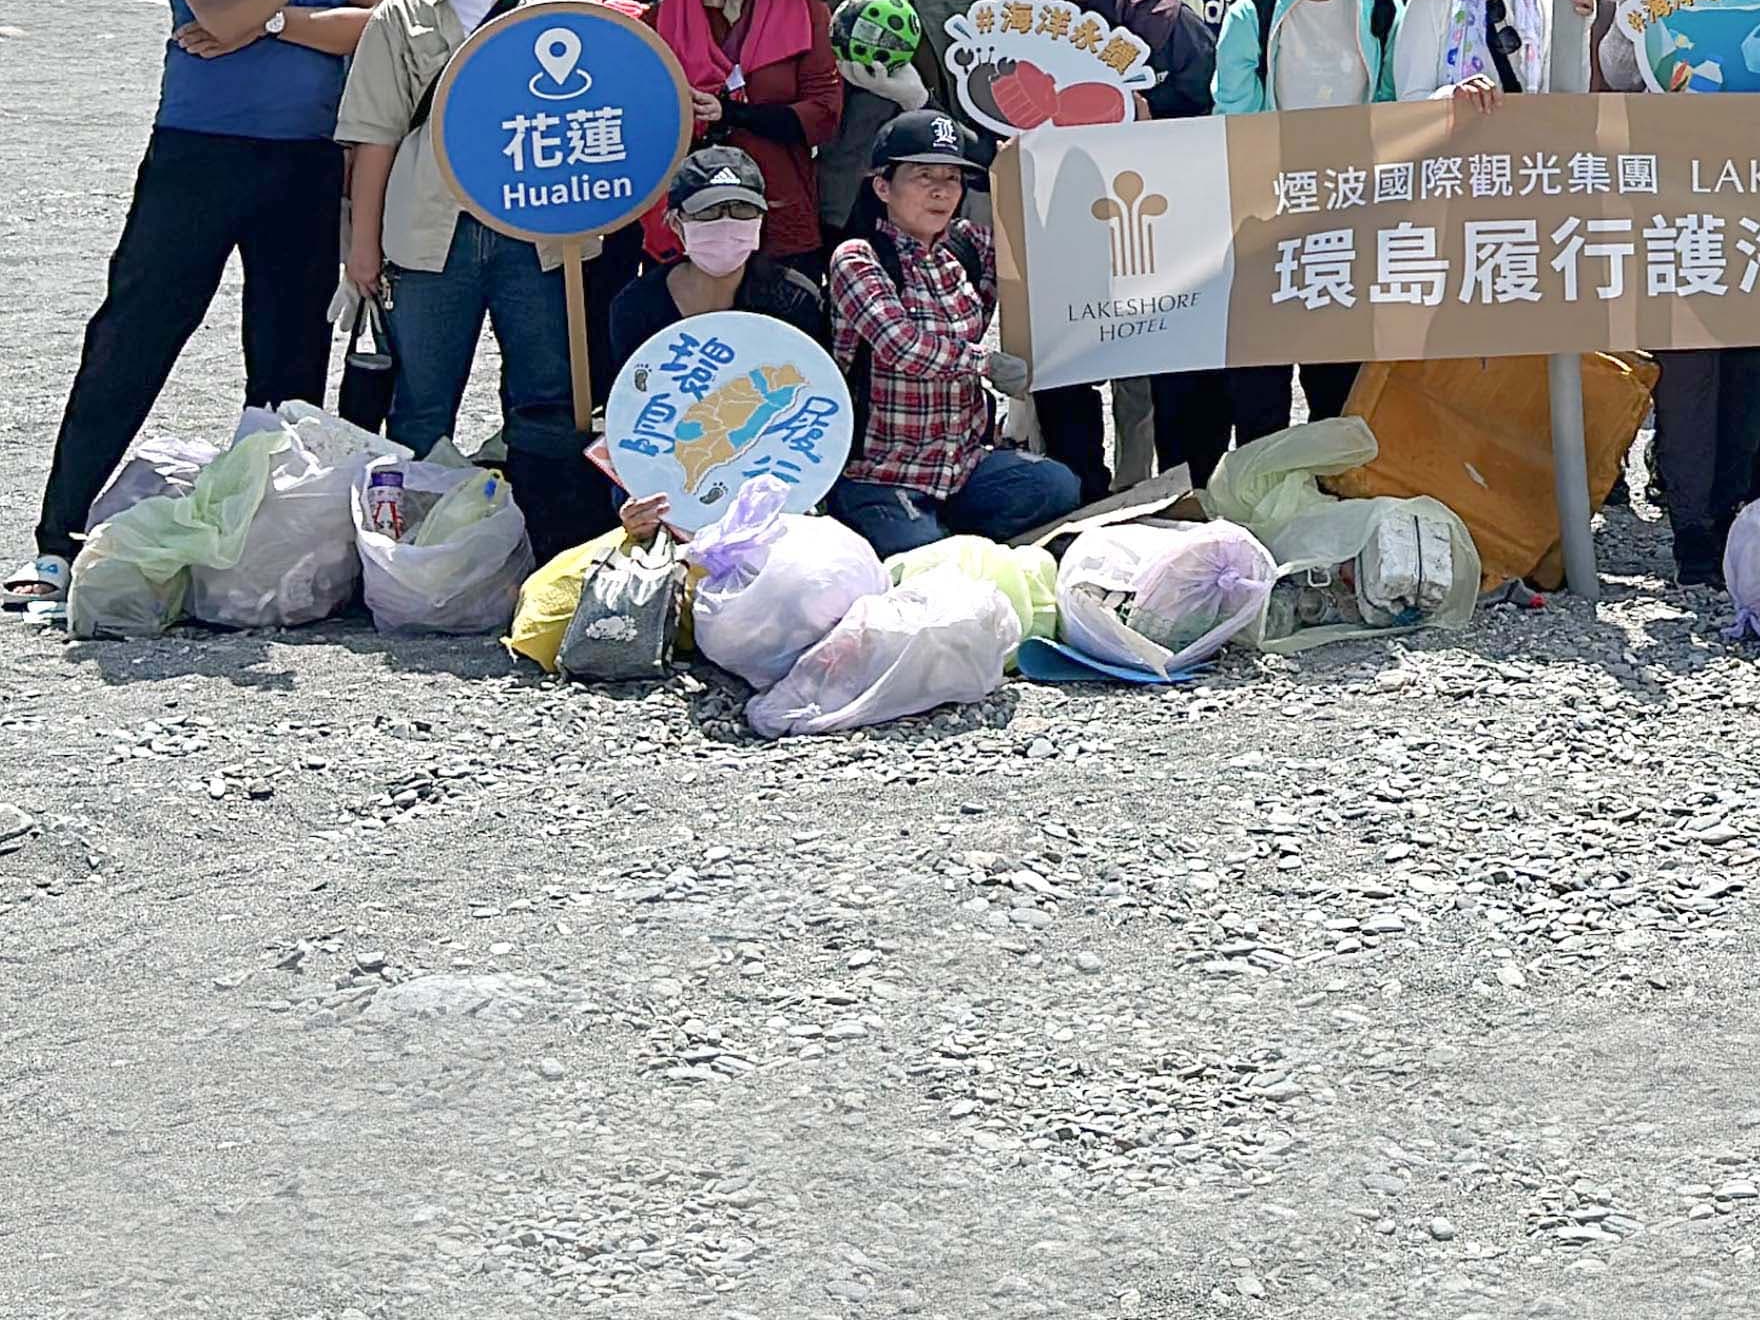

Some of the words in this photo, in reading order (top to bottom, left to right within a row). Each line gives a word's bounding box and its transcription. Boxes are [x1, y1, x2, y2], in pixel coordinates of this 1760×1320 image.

[975, 1, 1141, 75] #海洋永續
[502, 106, 627, 171] 花蓮
[503, 174, 632, 210] Hualien
[1272, 152, 1658, 216] 煙波國際觀光集團
[1068, 292, 1199, 322] LAKESHORE
[1099, 319, 1168, 342] HOTEL
